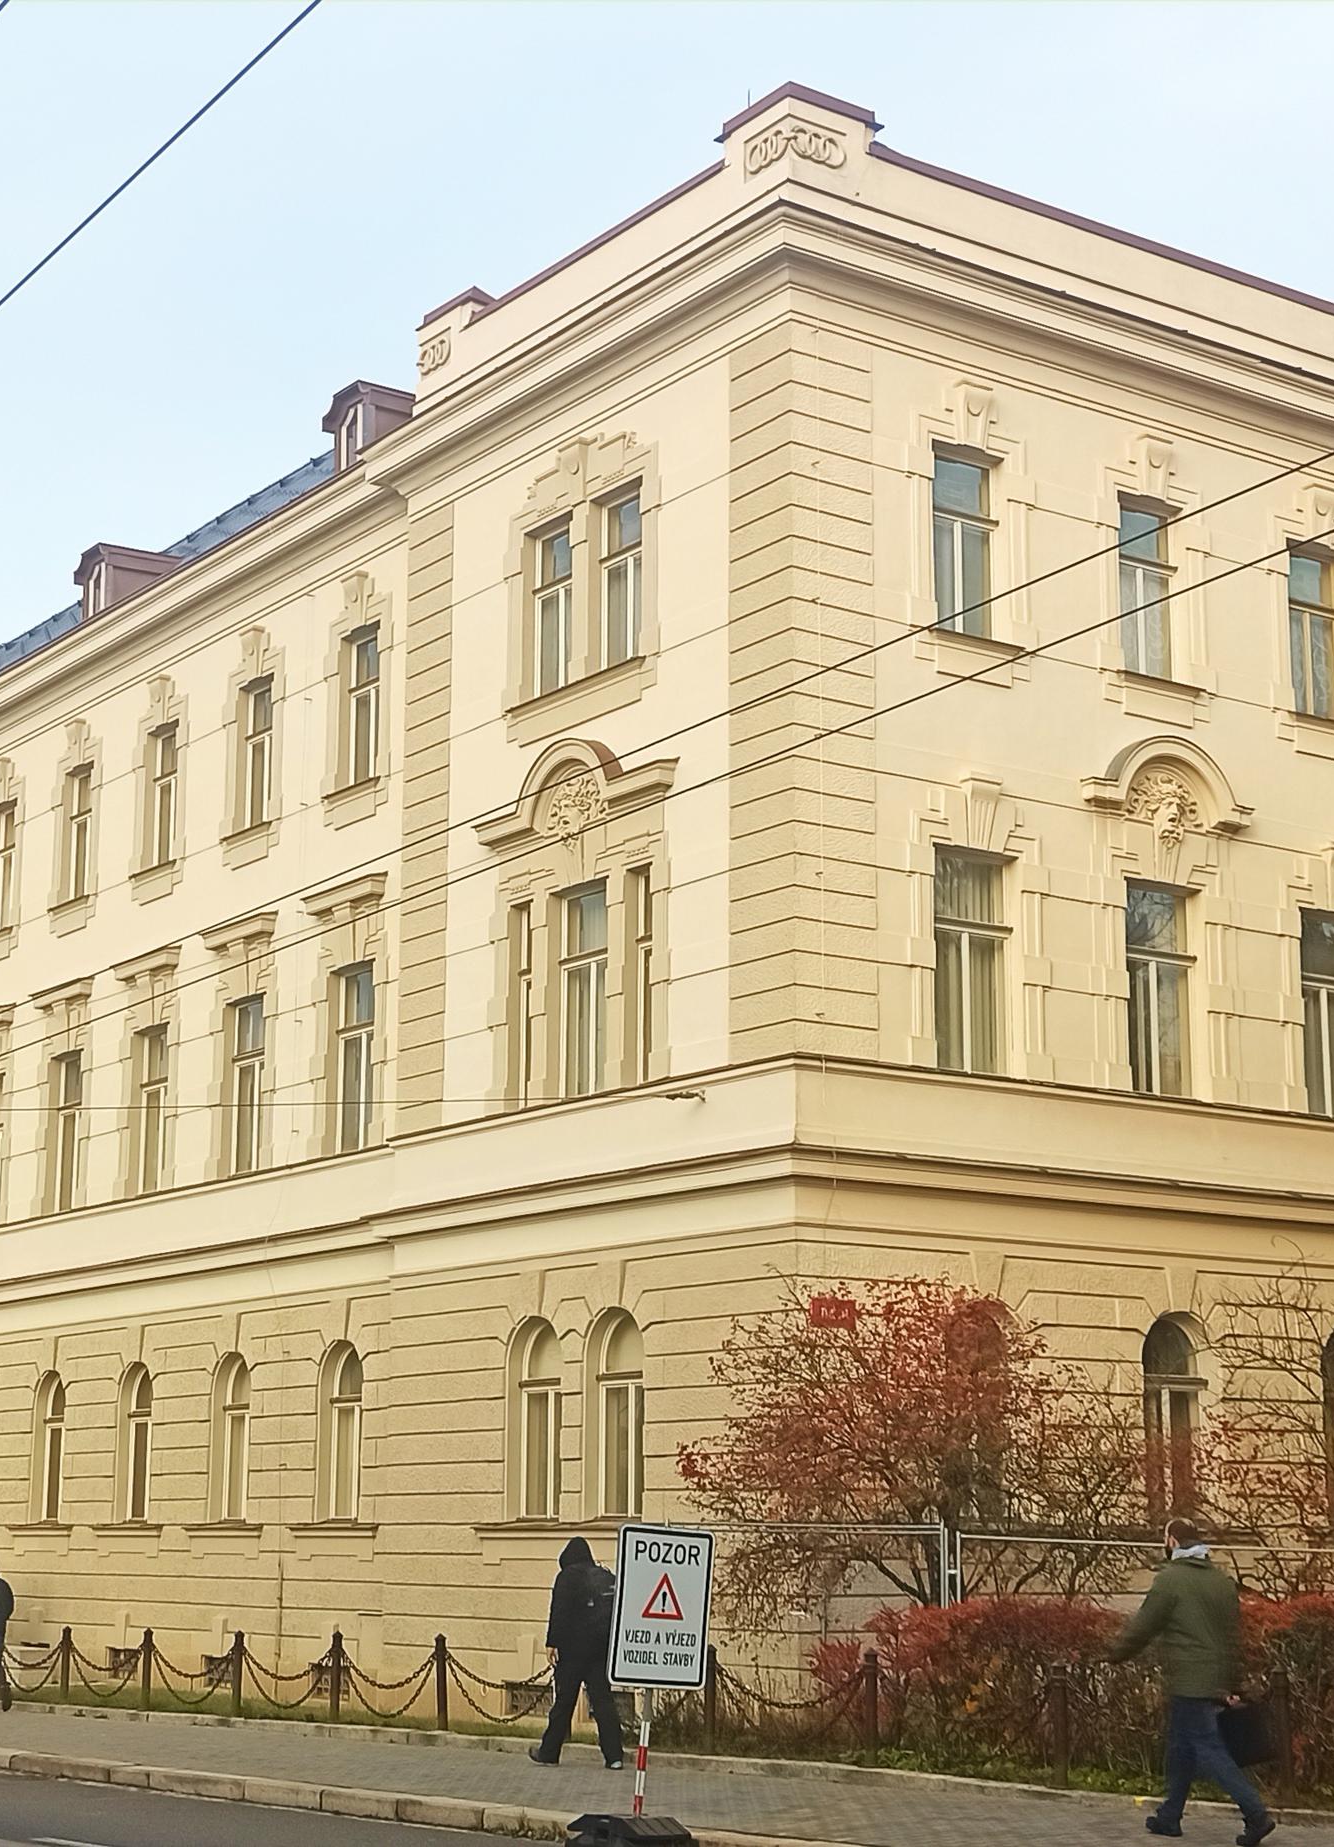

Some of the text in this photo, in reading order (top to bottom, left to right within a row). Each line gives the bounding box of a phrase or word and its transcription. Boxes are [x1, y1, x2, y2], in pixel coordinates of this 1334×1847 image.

[634, 1540, 701, 1566] POZOR
[625, 1629, 697, 1647] VJEZD A VÝJEZD
[623, 1650, 695, 1667] VOZIDEL STAVBY
